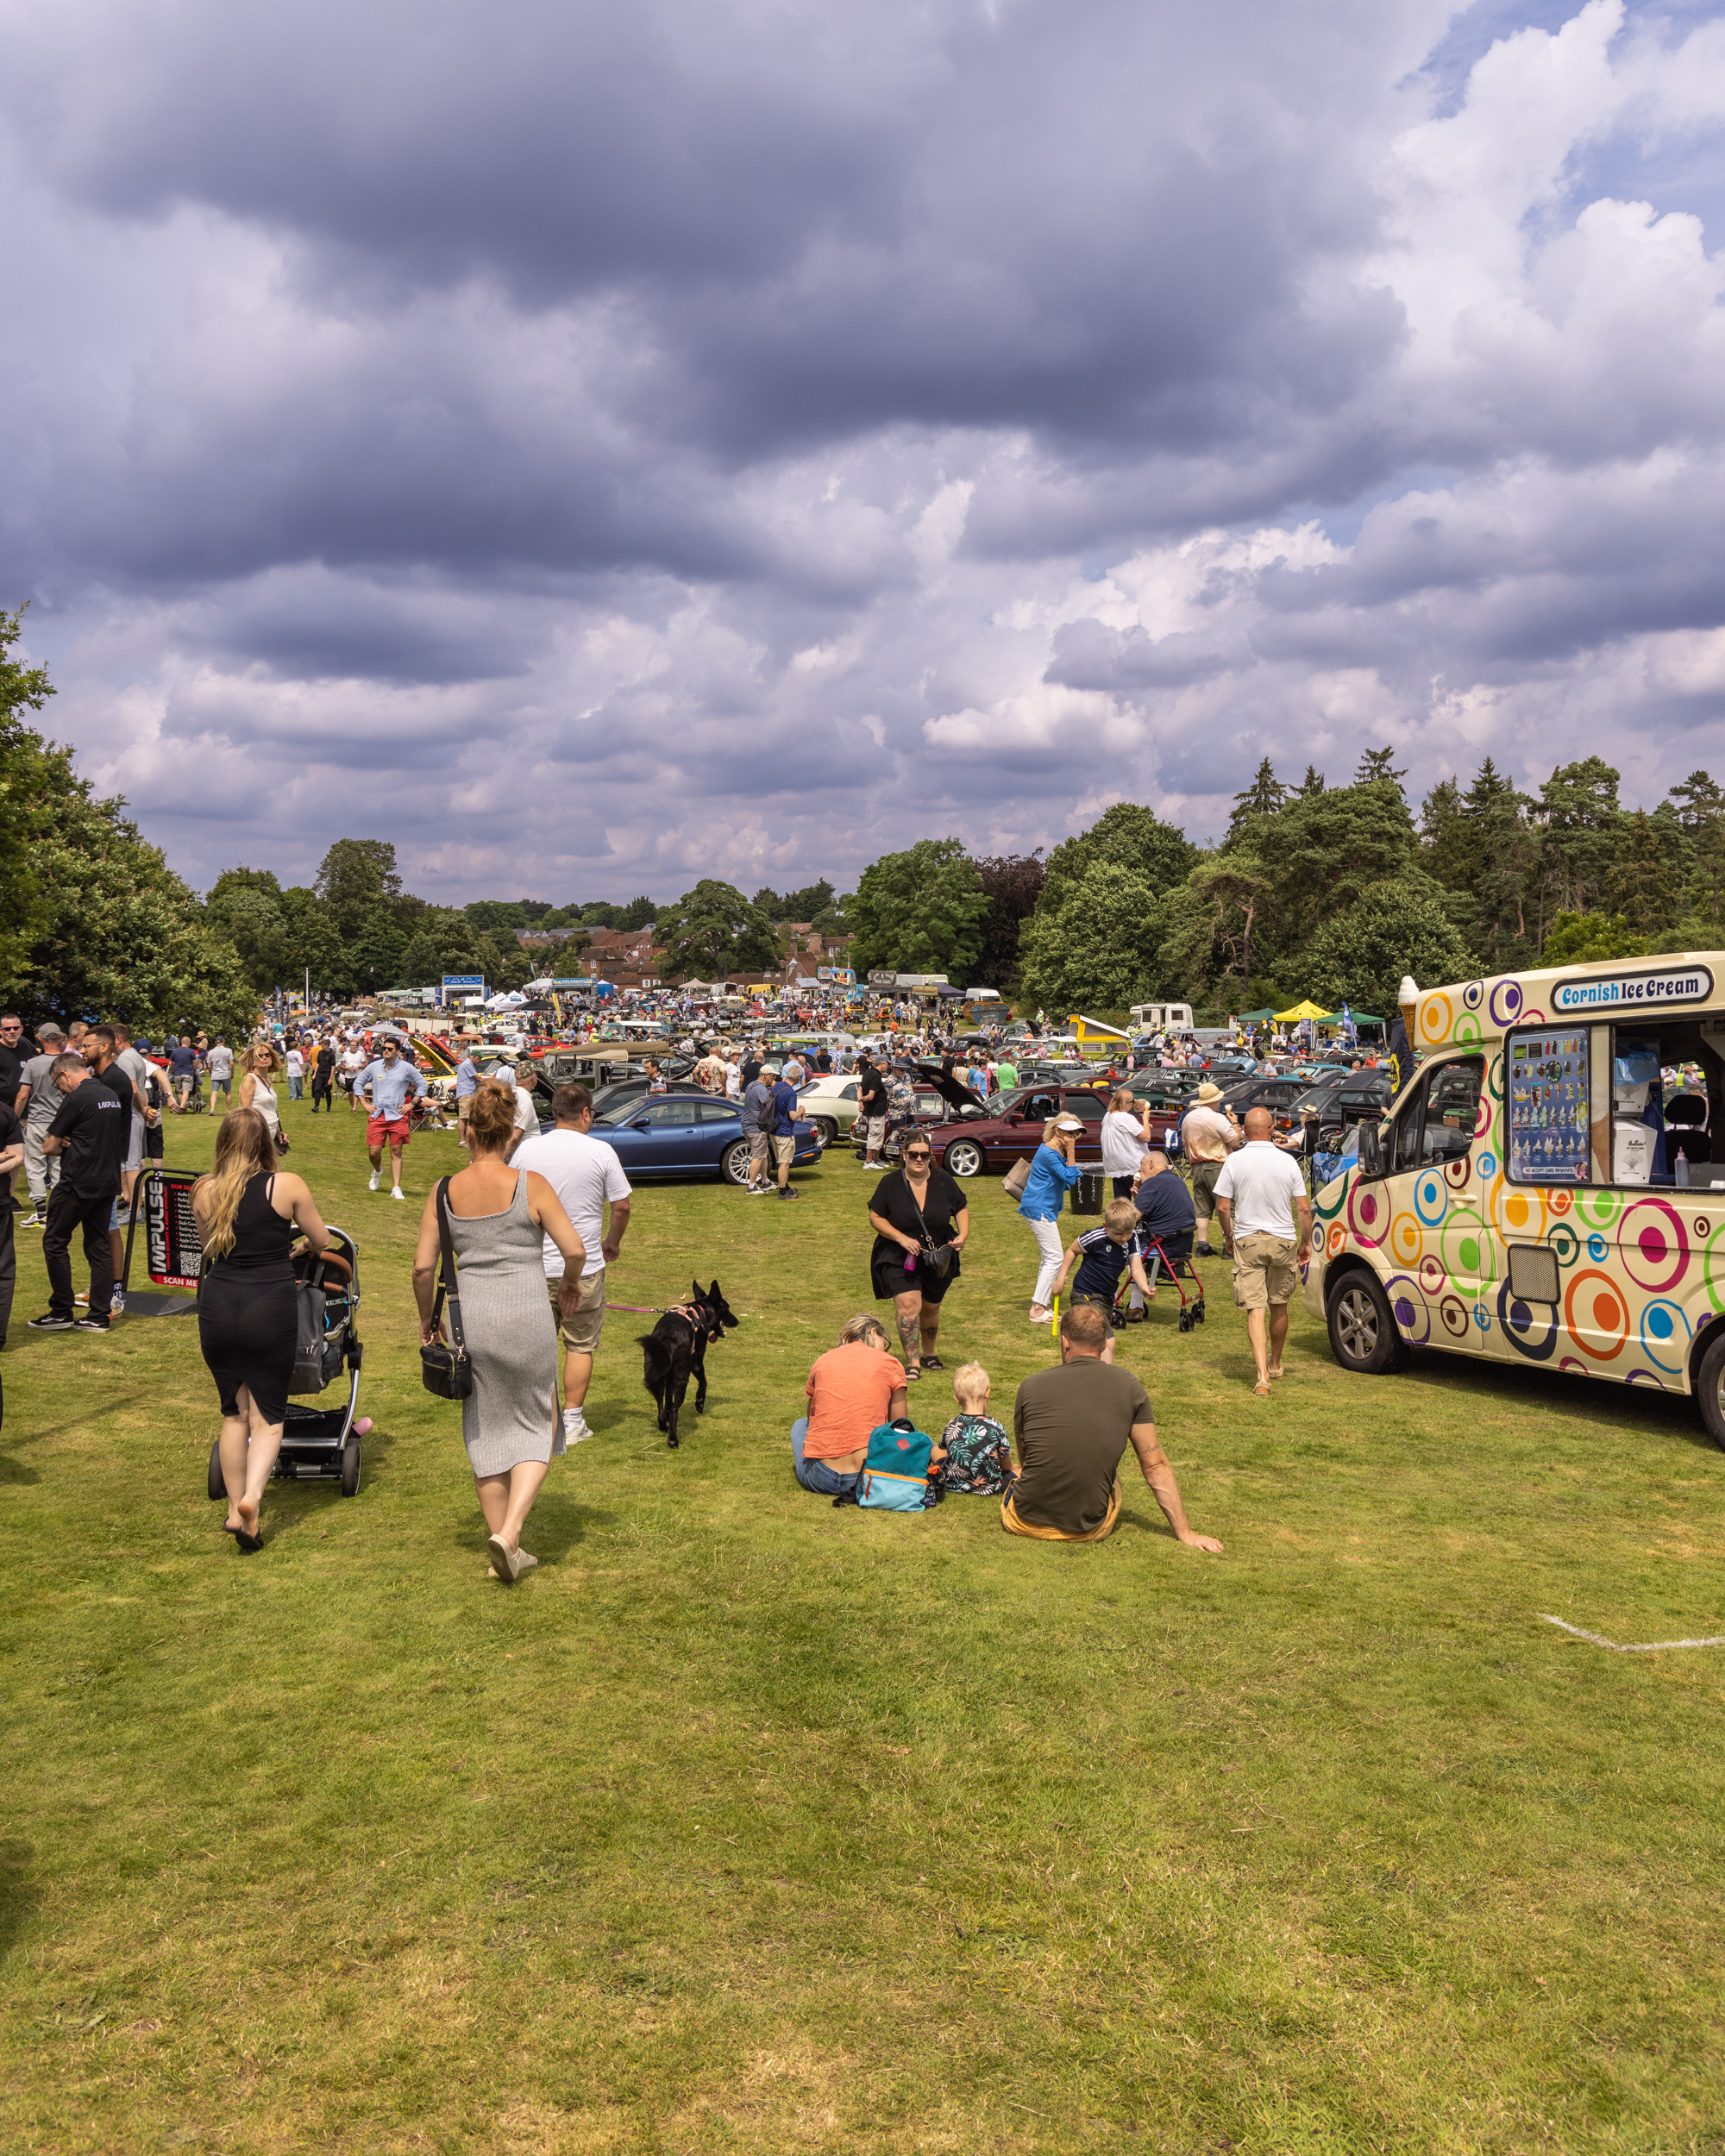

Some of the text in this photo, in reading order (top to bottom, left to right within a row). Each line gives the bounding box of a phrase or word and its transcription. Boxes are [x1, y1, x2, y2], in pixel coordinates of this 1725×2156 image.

[1562, 978, 1699, 1005] Cornish Ice Cream
[97, 1100, 122, 1110] IMPULS
[148, 1181, 166, 1273] IMPULSE
[163, 1276, 198, 1288] SCAN ME
